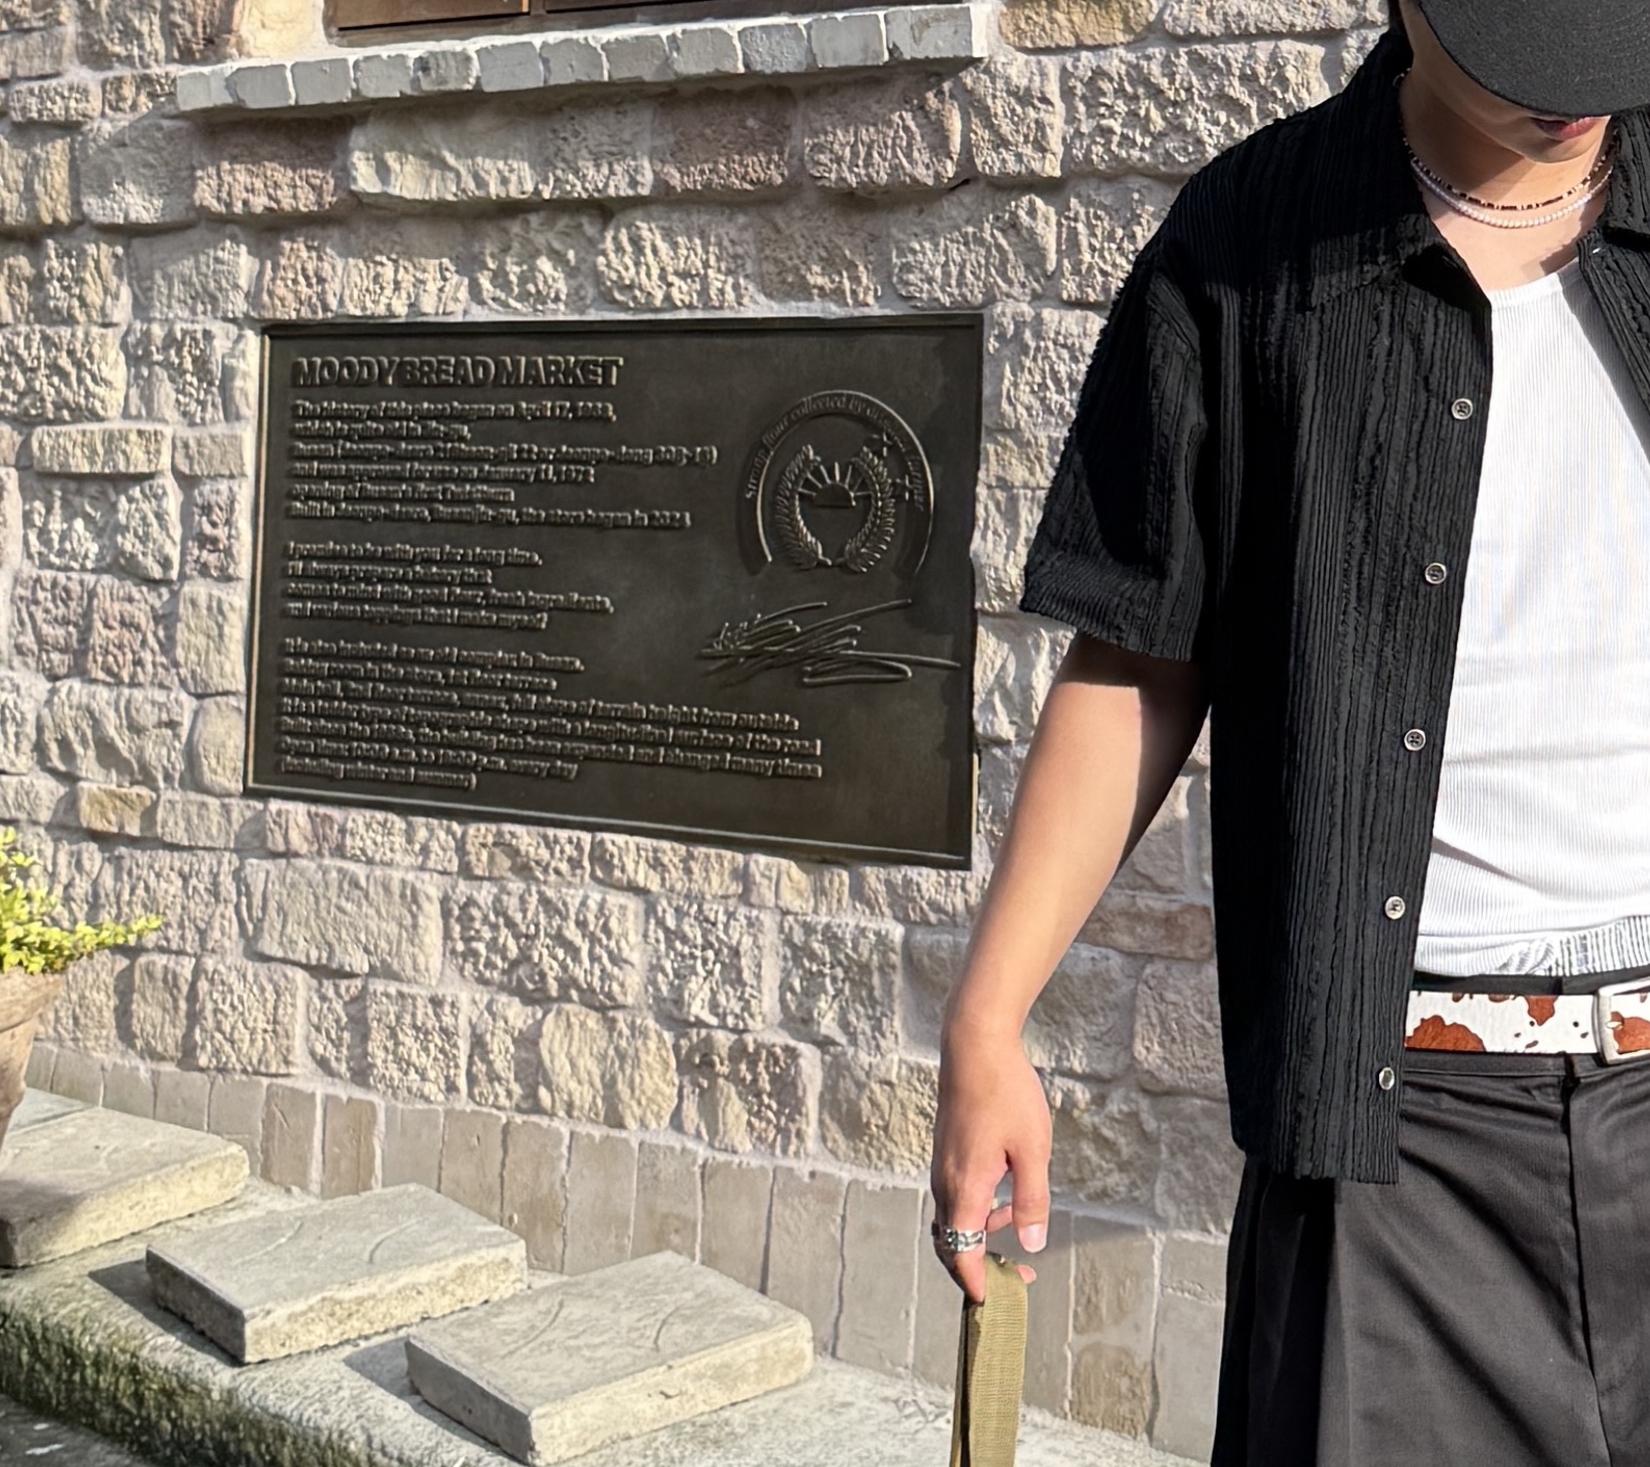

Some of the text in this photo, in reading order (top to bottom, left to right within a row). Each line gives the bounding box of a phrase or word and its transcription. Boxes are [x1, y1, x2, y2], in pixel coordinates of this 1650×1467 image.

[291, 355, 625, 387] MOODY BREAD MARKET
